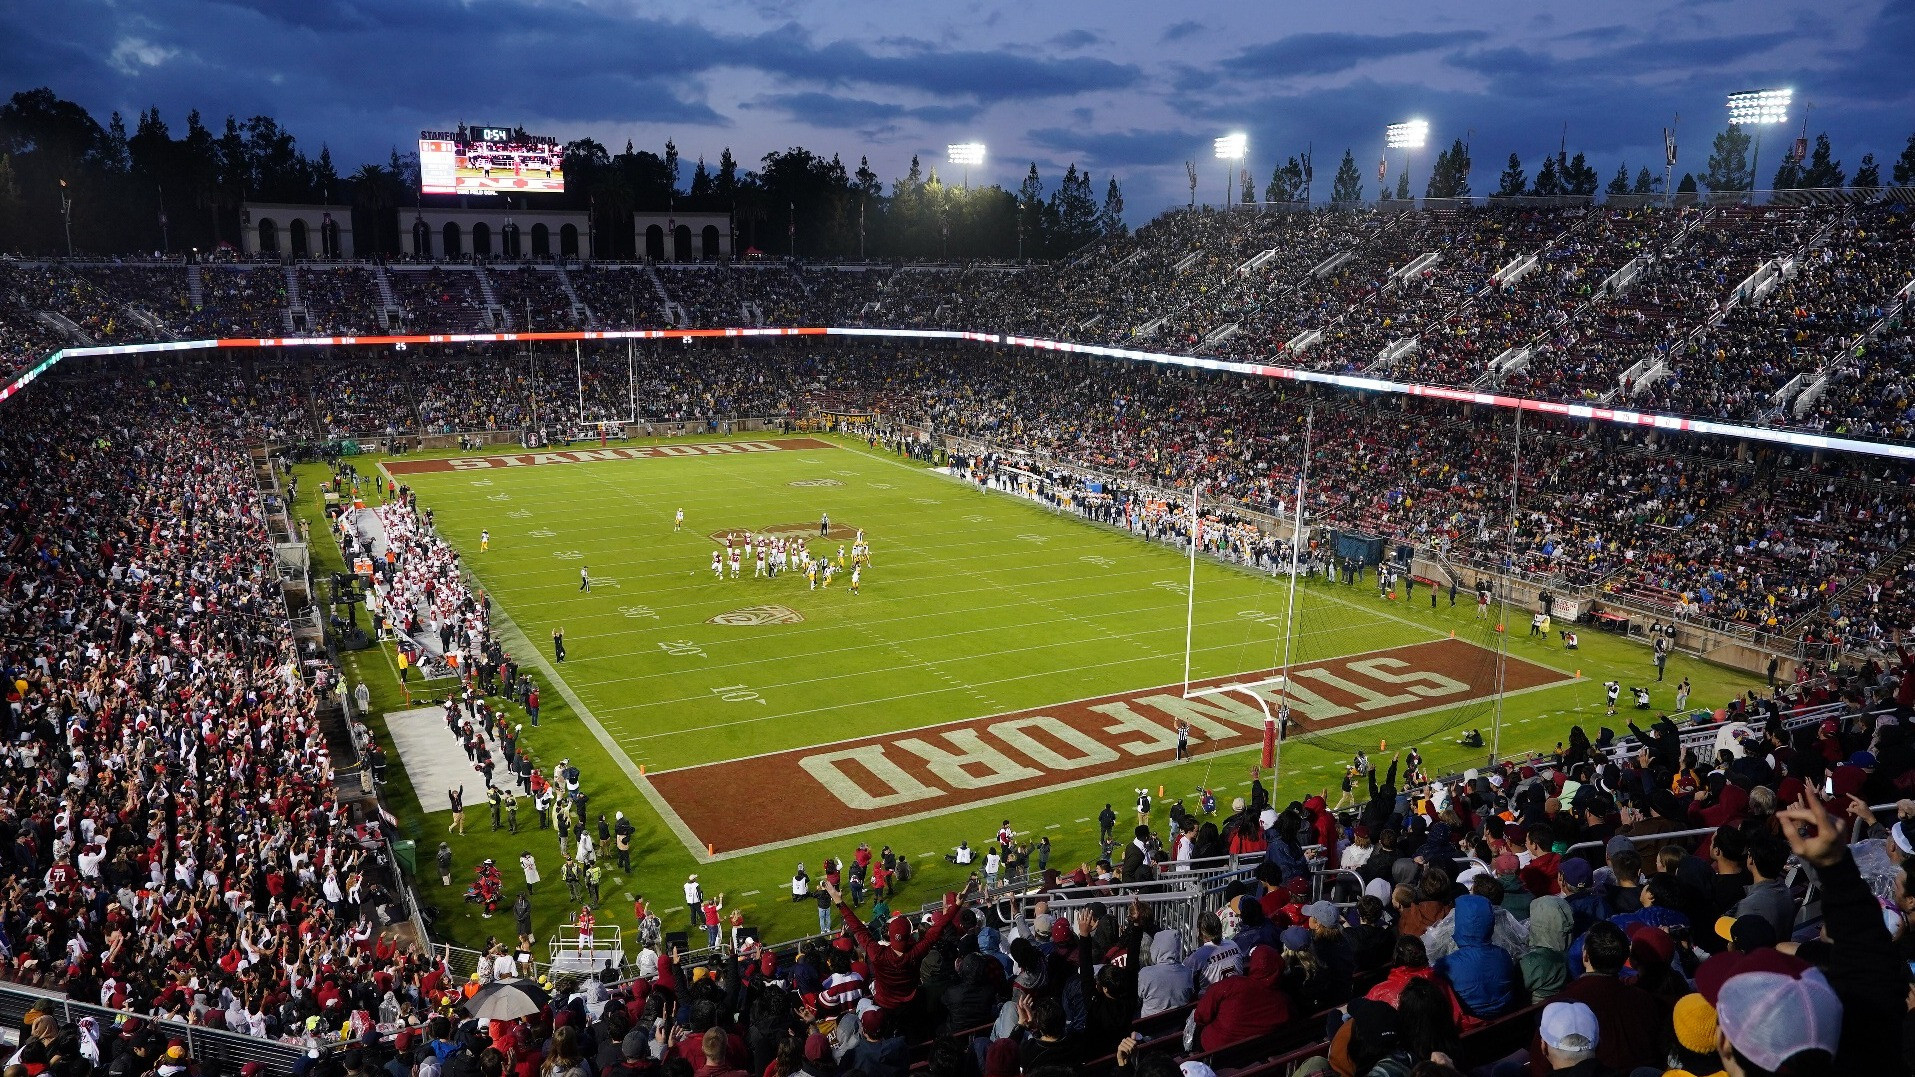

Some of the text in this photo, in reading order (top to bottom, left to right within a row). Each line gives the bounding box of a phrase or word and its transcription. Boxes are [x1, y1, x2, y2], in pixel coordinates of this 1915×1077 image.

[484, 129, 506, 140] 0:54
[395, 342, 407, 351] 25
[682, 336, 693, 344] 25
[447, 439, 783, 471] STANFORD
[710, 684, 760, 702] 10
[797, 656, 1472, 810] STANFORD
[54, 871, 66, 882] 77
[1207, 947, 1239, 965] STANFORD
